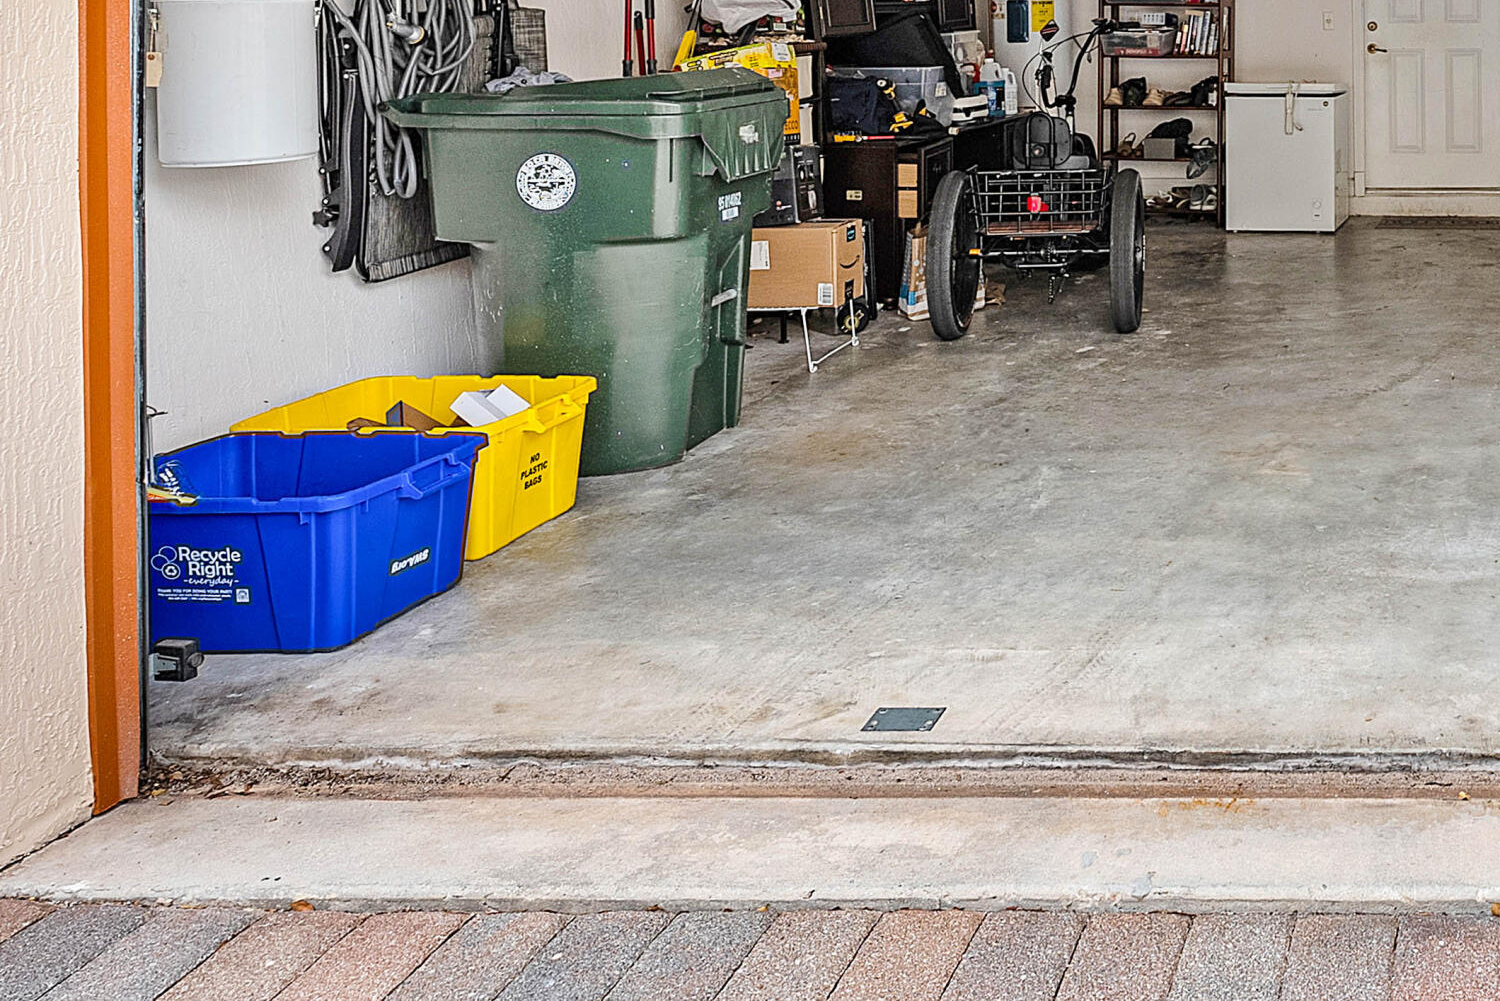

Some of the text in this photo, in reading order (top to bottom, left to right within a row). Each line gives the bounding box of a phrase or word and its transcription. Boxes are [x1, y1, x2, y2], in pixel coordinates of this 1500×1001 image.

[530, 452, 541, 464] NO
[520, 460, 548, 481] PLASTIC
[524, 474, 542, 490] BAGS
[178, 546, 241, 565] Recycle
[391, 548, 430, 574] SWA.org
[188, 561, 234, 579] Right
